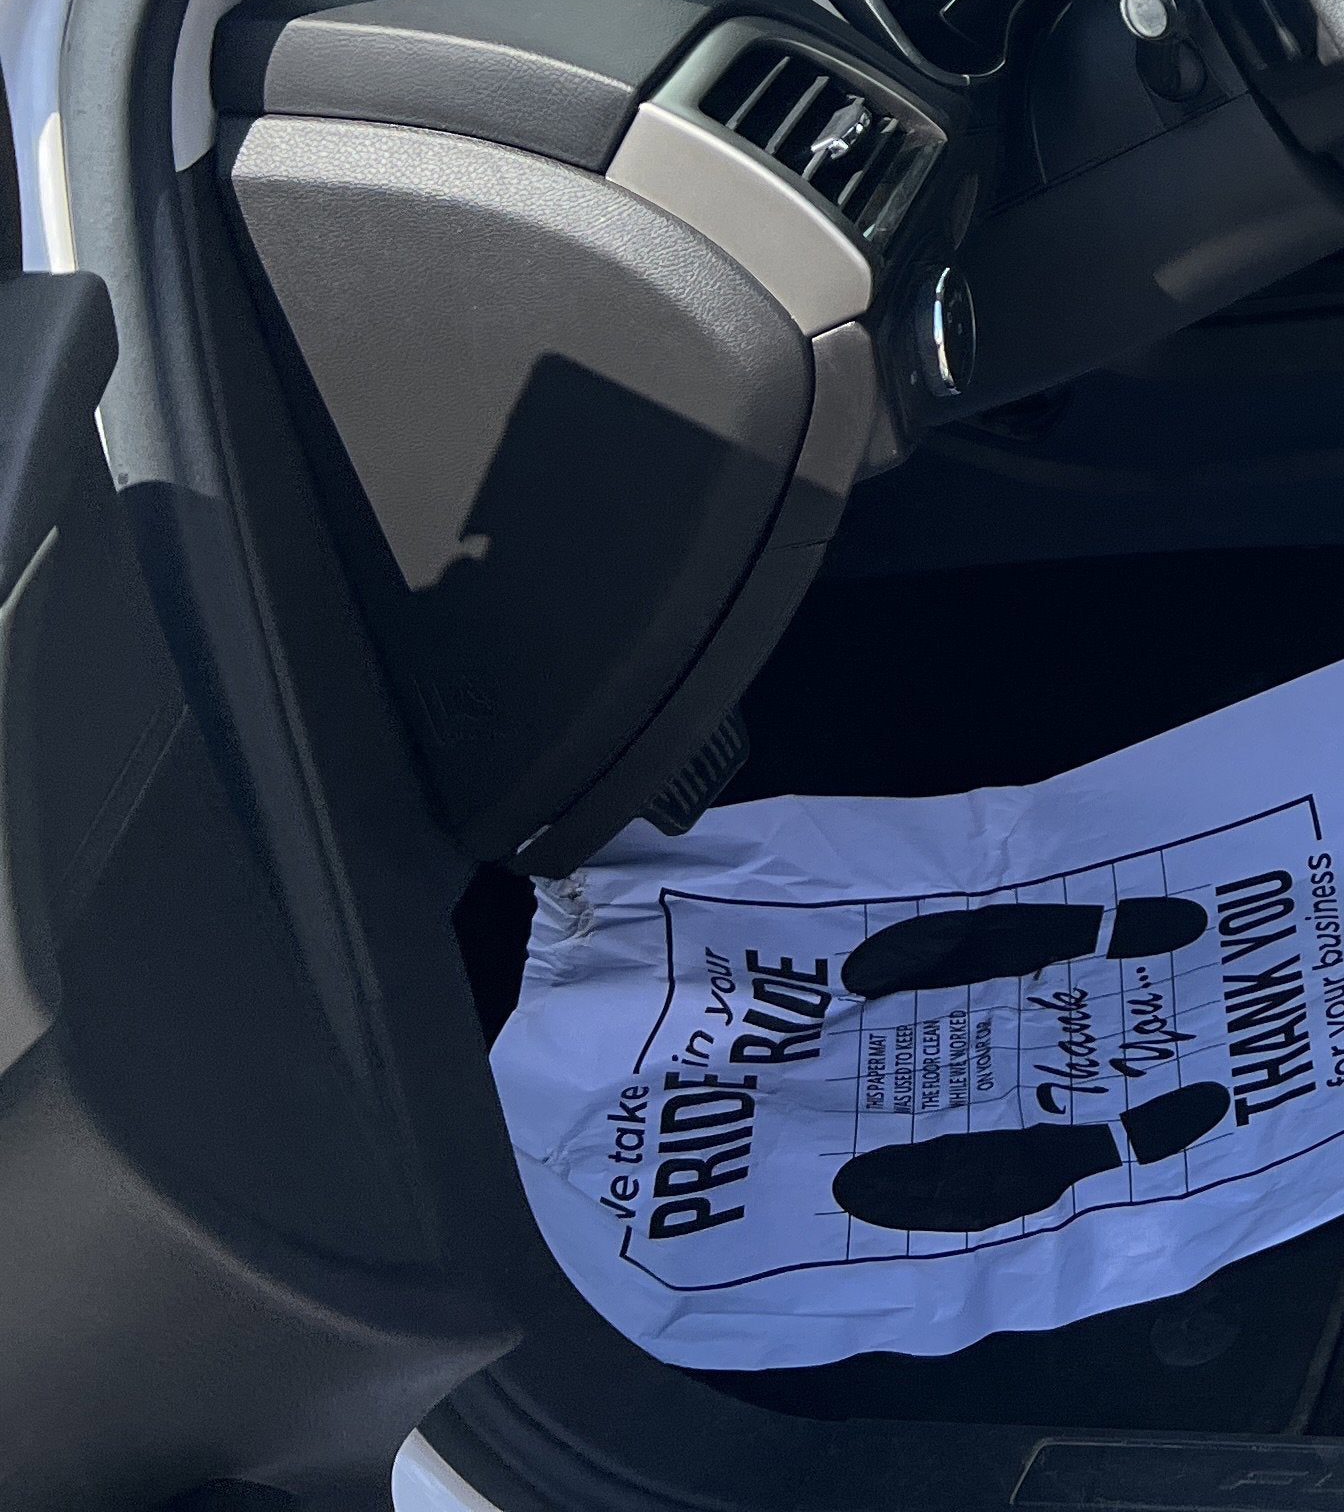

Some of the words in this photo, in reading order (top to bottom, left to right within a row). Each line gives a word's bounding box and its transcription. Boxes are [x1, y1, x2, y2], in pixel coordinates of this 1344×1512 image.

[1215, 870, 1298, 965] YOU
[1305, 852, 1343, 970] business
[704, 946, 736, 1026] your
[729, 949, 833, 1064] RIDE
[671, 1029, 715, 1067] in
[869, 1033, 887, 1057] MAT
[896, 1025, 913, 1050] KEEP
[923, 1020, 941, 1056] CLEAN
[950, 1010, 967, 1060] WORKED
[1026, 985, 1109, 1115] Thank
[1223, 953, 1316, 1127] THANK
[866, 1057, 886, 1090] PAPER
[895, 1052, 912, 1067] TO
[923, 1057, 940, 1089] FLOOR
[950, 1060, 967, 1076] WE
[895, 1068, 912, 1094] USED
[950, 1078, 967, 1108] WHILE
[976, 1071, 994, 1091] ON
[866, 1091, 884, 1110] THIS
[922, 1089, 940, 1110] THE
[607, 1085, 649, 1164] take
[649, 1071, 758, 1239] PRIDE
